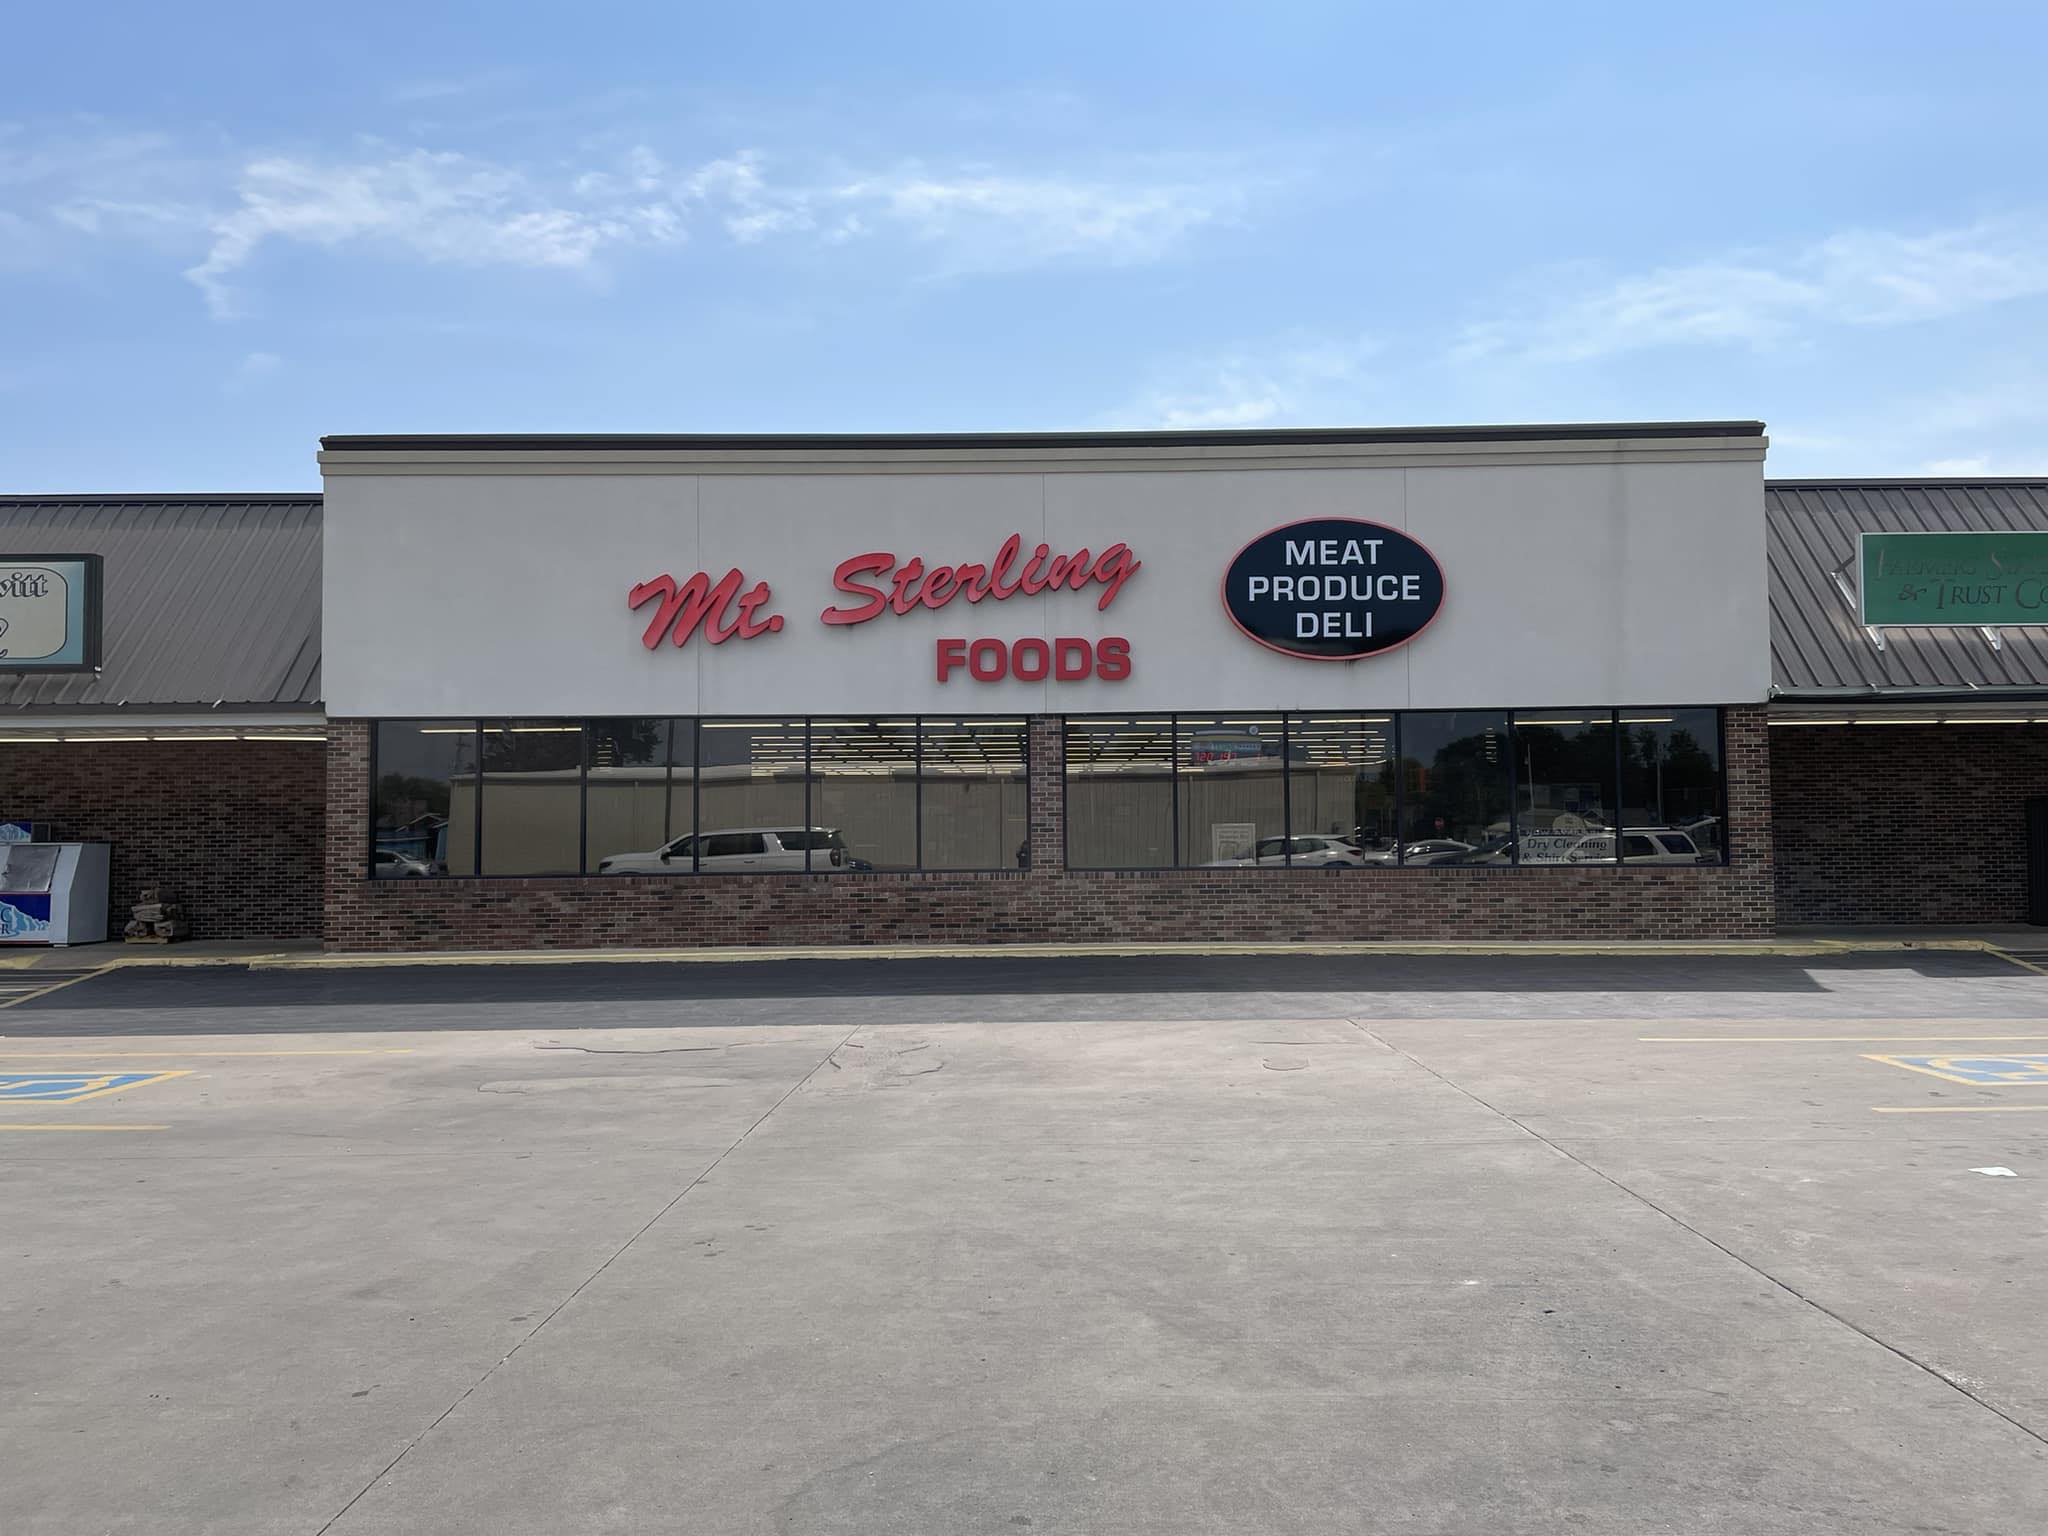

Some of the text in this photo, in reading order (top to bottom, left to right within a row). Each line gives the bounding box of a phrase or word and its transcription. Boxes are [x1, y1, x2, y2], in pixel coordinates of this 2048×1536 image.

[1285, 540, 1383, 565] MEAT
[628, 533, 1142, 650] Mt. Sterling
[1249, 575, 1420, 601] PRODUCE
[1930, 578, 2007, 610] TRUST
[1296, 612, 1373, 638] DELI
[936, 637, 1131, 682] FOODS
[1527, 838, 1607, 851] Dry Cleaning
